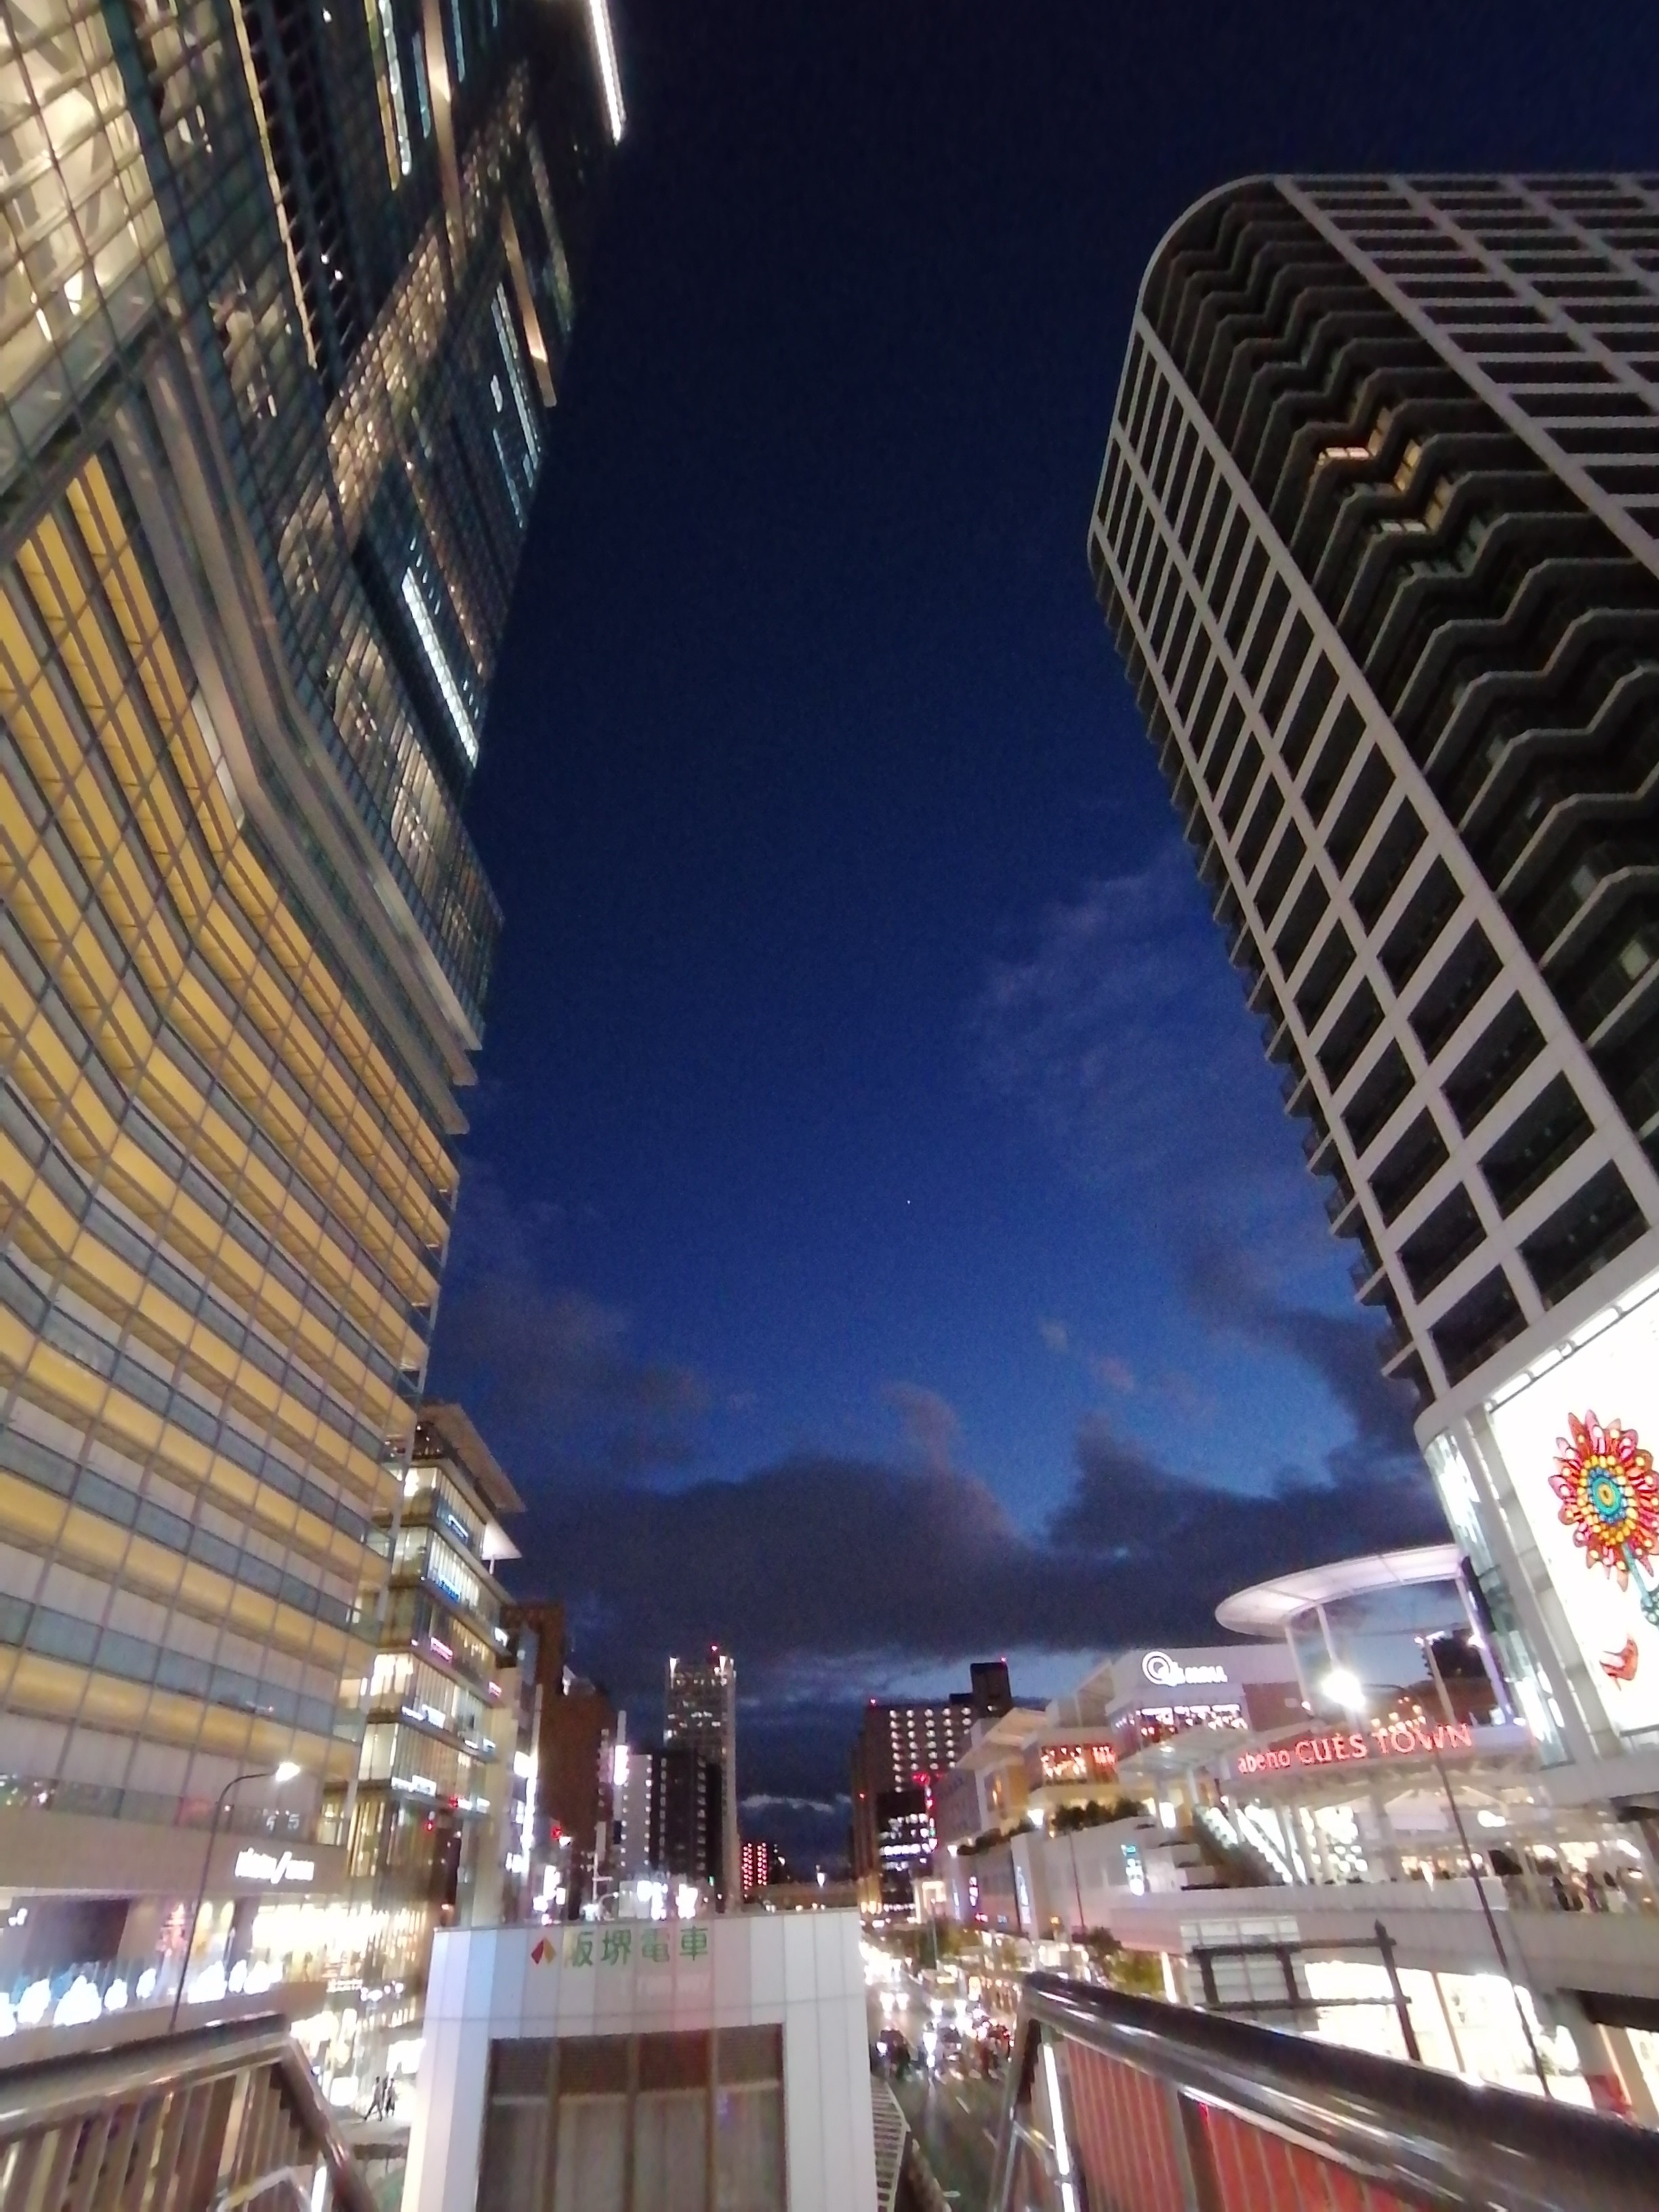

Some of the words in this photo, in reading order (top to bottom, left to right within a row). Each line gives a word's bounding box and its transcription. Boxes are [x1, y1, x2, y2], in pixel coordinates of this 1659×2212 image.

[1237, 1750, 1290, 1774] abeno
[1371, 1723, 1472, 1754] TOWN
[562, 1926, 708, 1967] 阪堺電車
